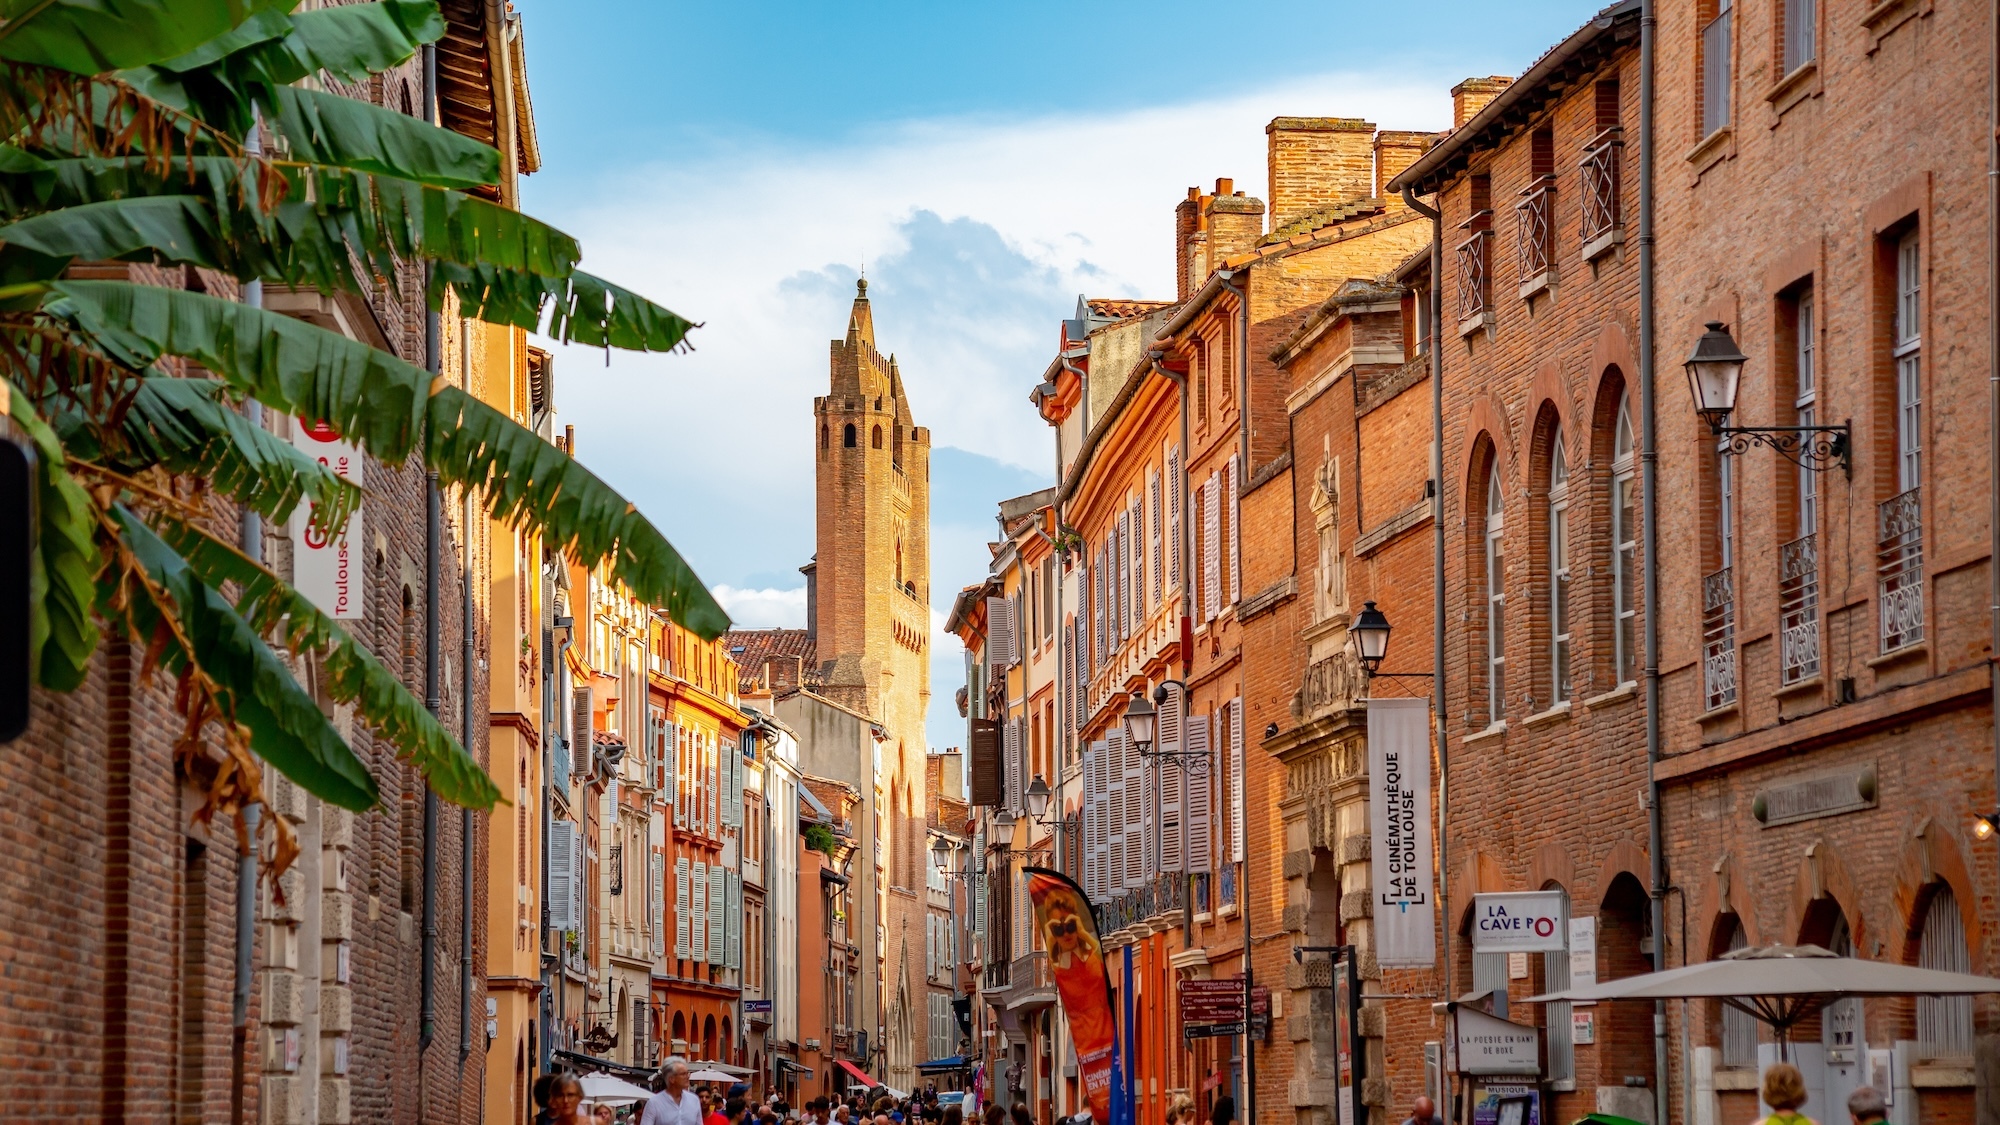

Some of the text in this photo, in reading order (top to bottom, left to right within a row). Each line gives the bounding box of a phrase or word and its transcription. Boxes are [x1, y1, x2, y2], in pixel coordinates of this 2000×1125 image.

[1384, 752, 1401, 897] LA CINÉMATHÈQUE
[1402, 789, 1416, 897] DE TOULOUSE
[1489, 905, 1508, 917] LA
[1480, 918, 1521, 930] CAVE
[1088, 1076, 1111, 1090] EN PLE
